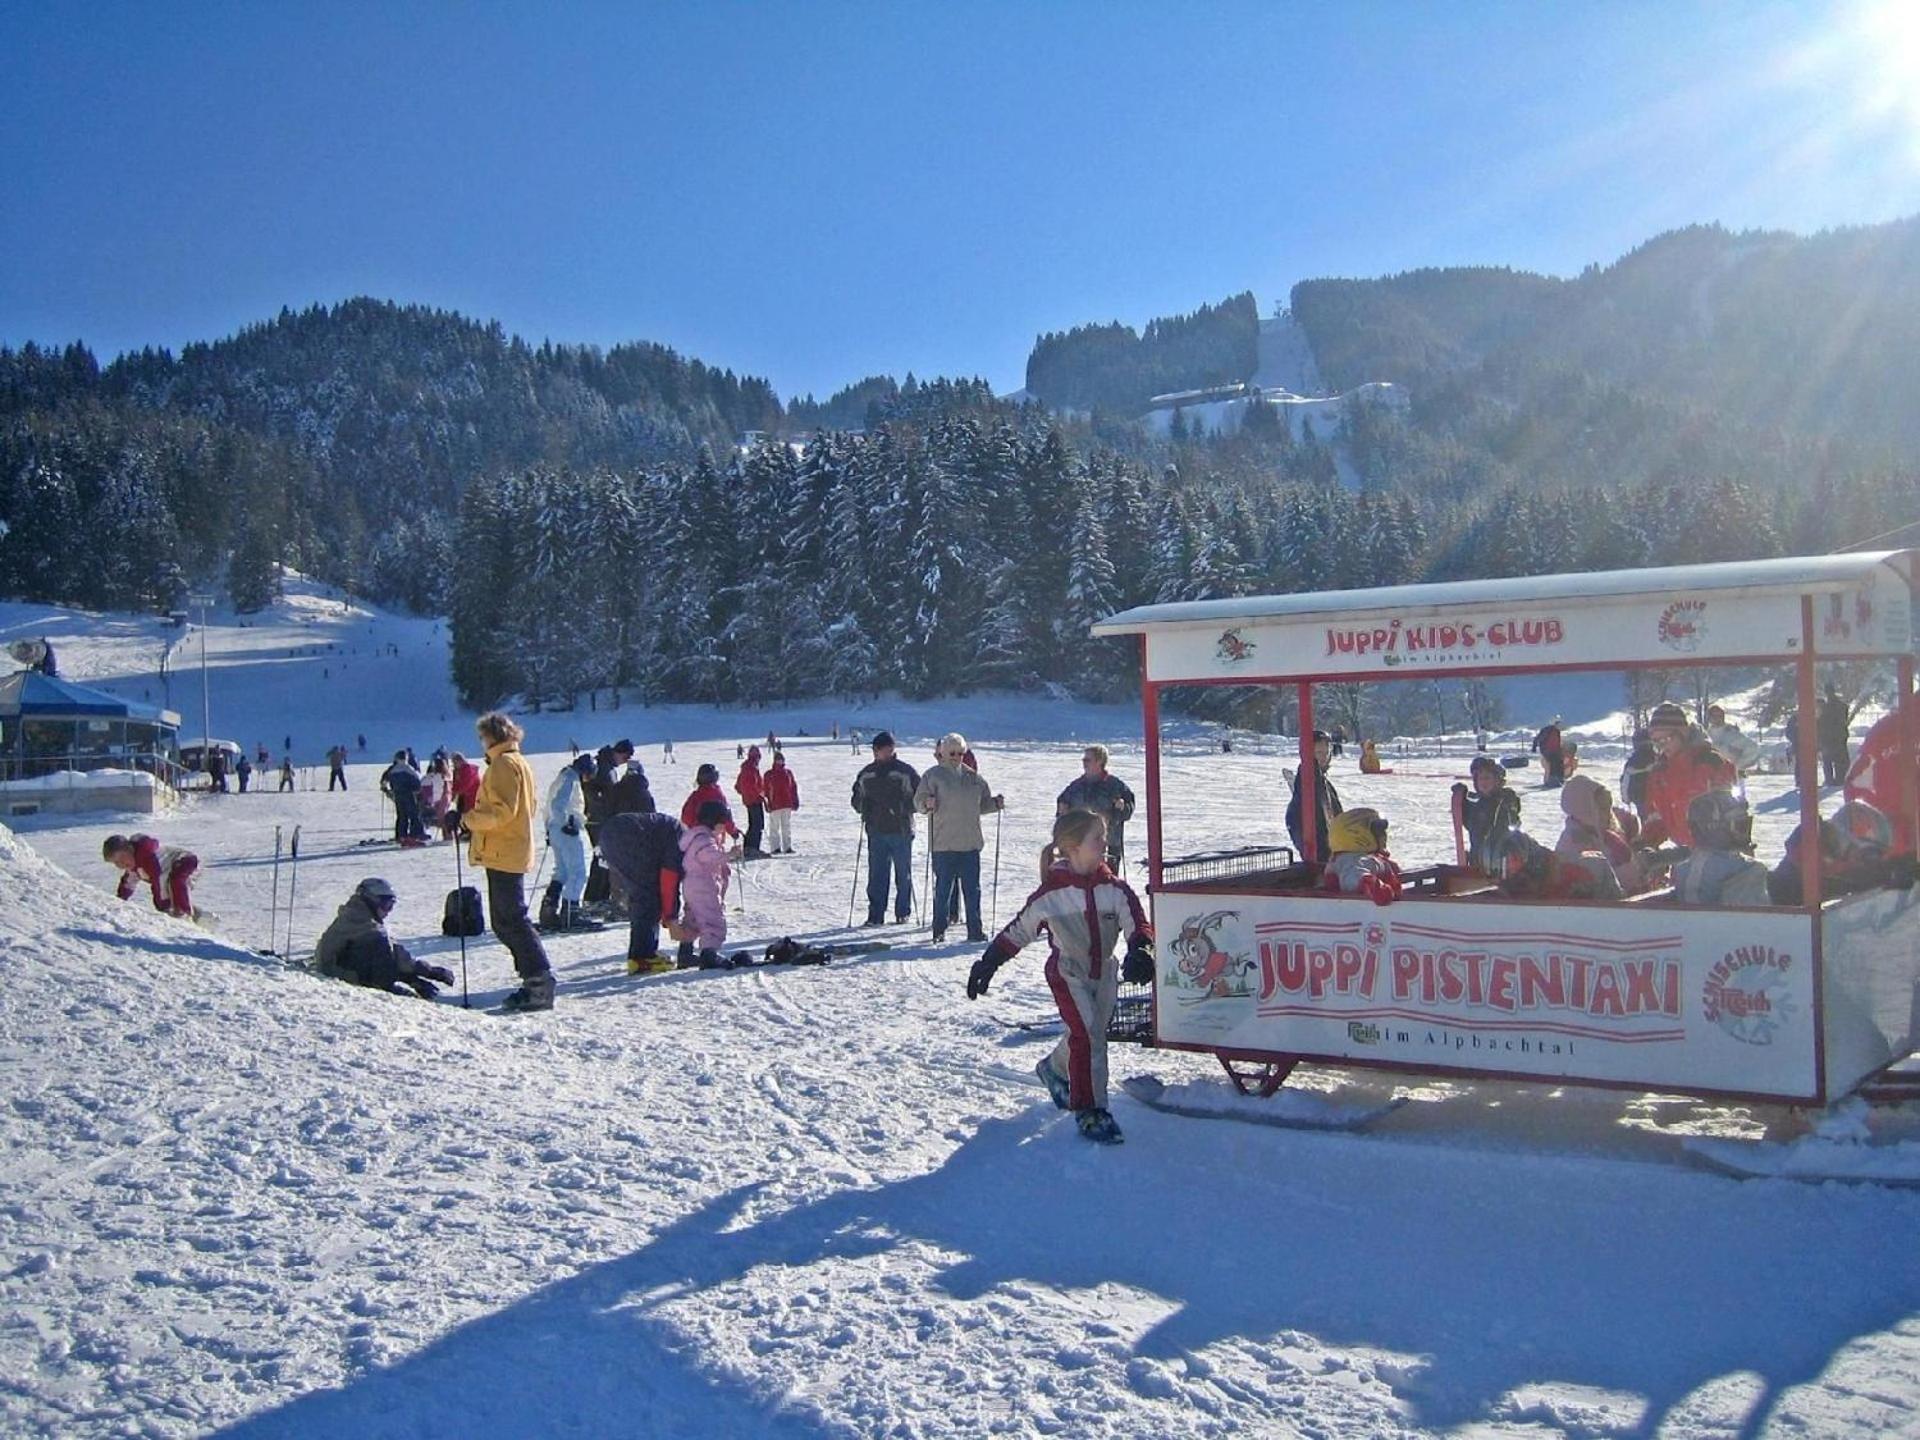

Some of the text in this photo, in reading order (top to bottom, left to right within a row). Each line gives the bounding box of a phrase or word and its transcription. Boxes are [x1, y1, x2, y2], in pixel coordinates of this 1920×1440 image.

[1390, 946, 1684, 1018] PISTENTAXI
[1385, 1027, 1409, 1043] im
[1425, 1031, 1575, 1056] Alpbachtal
